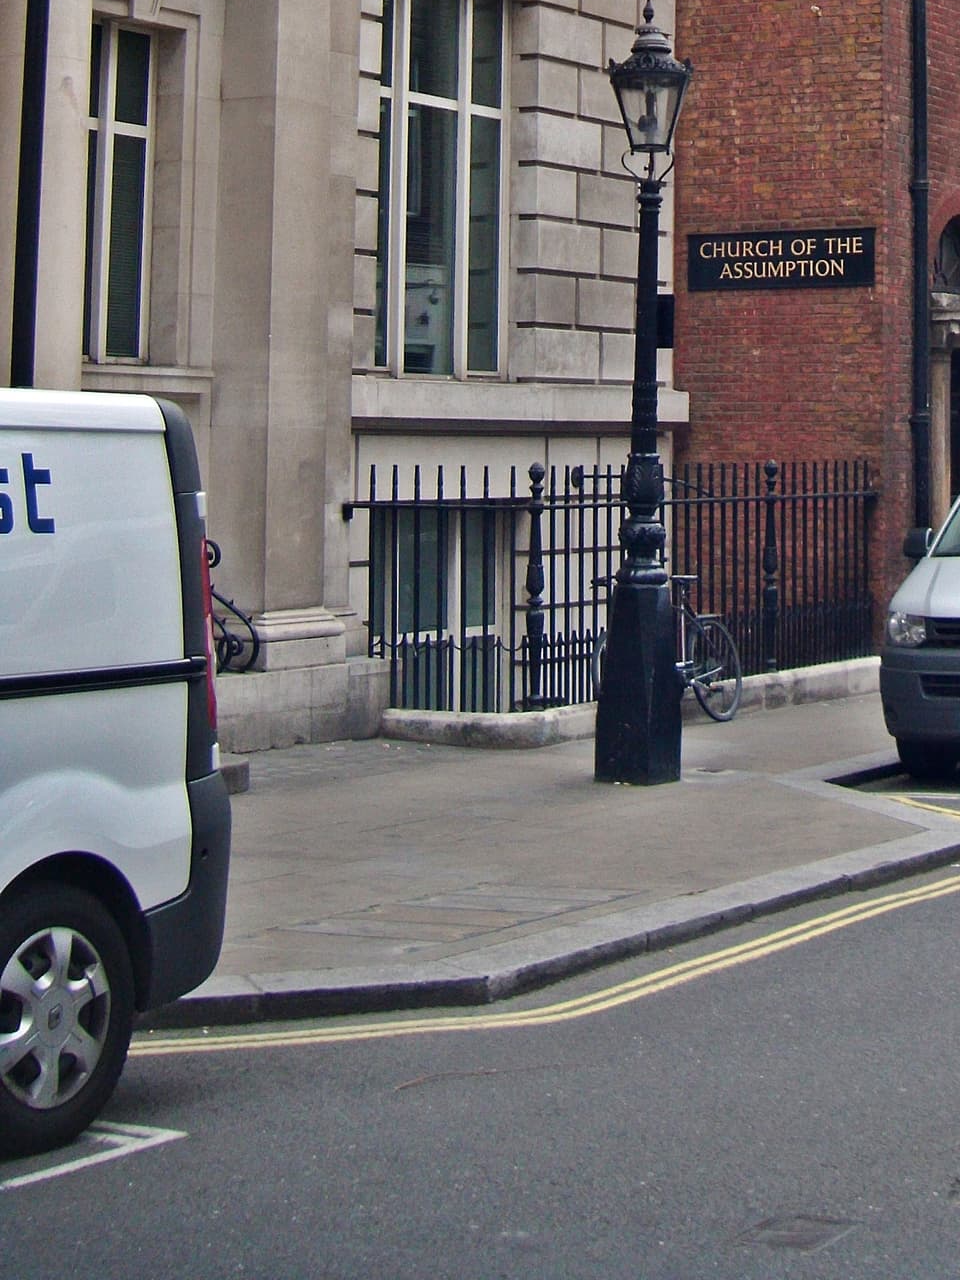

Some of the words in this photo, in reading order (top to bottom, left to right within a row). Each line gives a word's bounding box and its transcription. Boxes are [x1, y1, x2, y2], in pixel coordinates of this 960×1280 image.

[699, 240, 783, 259] CHURCH
[790, 238, 817, 256] OF
[823, 236, 863, 254] THE
[719, 259, 845, 279] ASSUMPTION
